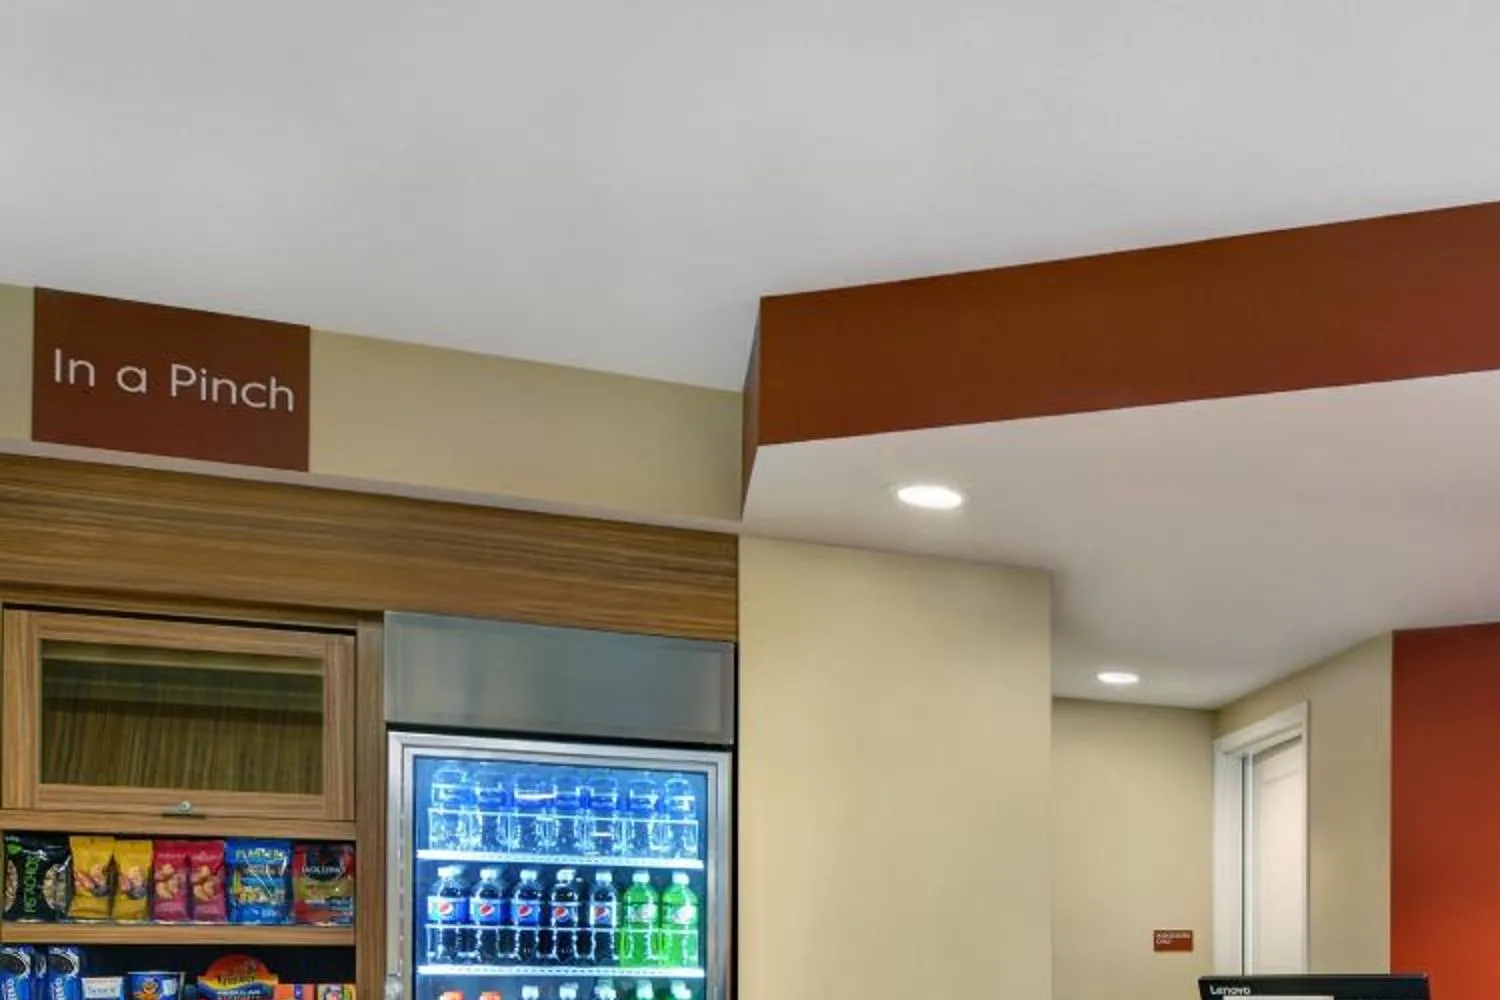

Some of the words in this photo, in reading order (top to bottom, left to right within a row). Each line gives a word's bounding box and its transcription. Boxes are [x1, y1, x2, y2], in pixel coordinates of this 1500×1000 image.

[54, 348, 96, 388] In
[116, 365, 148, 394] a
[170, 363, 295, 412] Pinch
[1209, 984, 1251, 995] Lenovo
